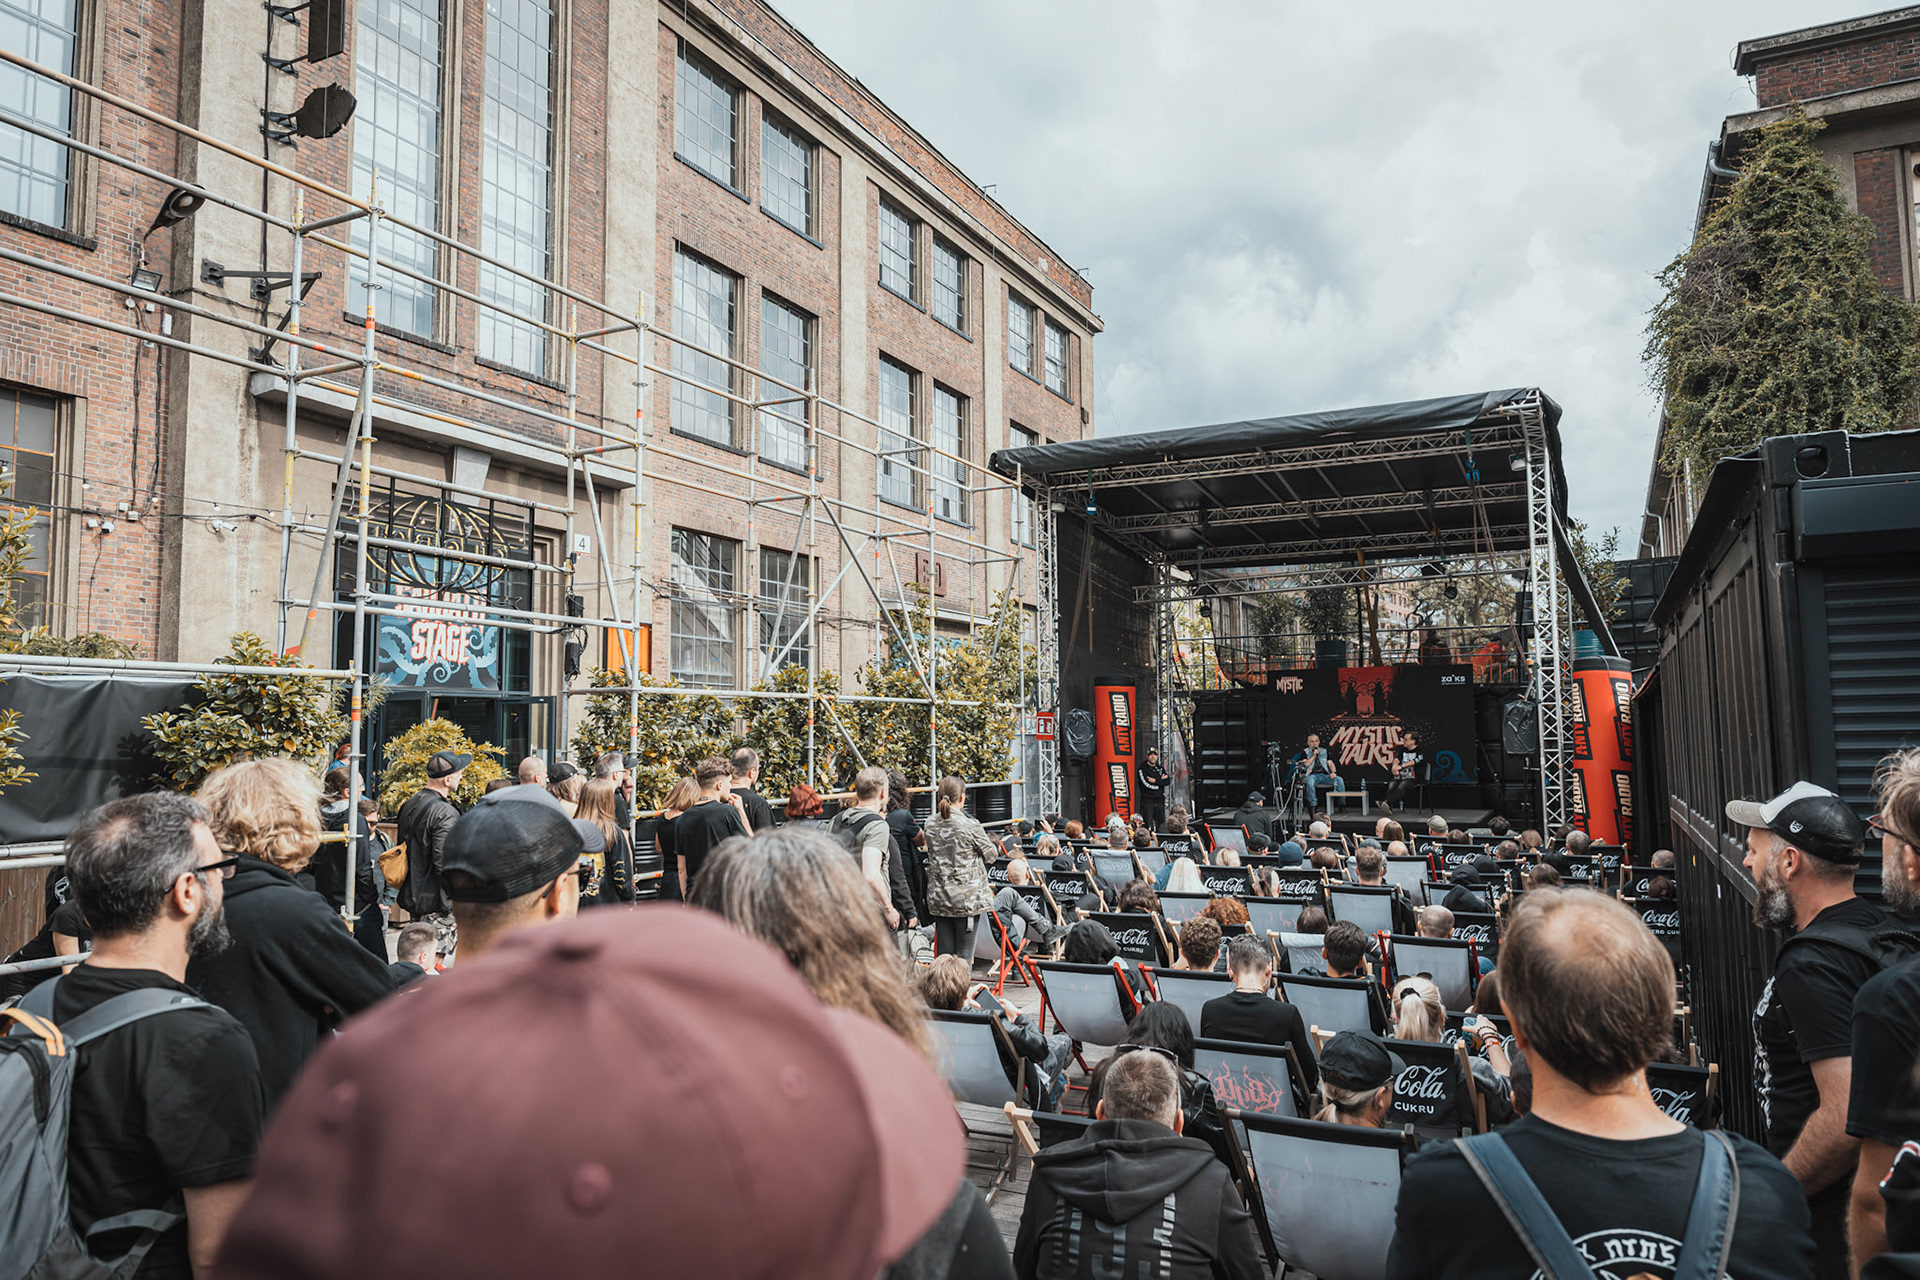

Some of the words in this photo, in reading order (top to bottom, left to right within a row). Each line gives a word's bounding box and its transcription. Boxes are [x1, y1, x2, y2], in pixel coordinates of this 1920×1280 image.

[578, 537, 586, 551] 4
[411, 620, 472, 665] STAGE
[1111, 694, 1131, 752] ANTYRADIO
[1329, 725, 1405, 747] MYSTIC
[1339, 742, 1395, 771] TALKS
[1049, 879, 1084, 894] Coca-Cola
[1204, 876, 1245, 893] Coca-Cola
[1394, 1101, 1435, 1114] CUKRU
